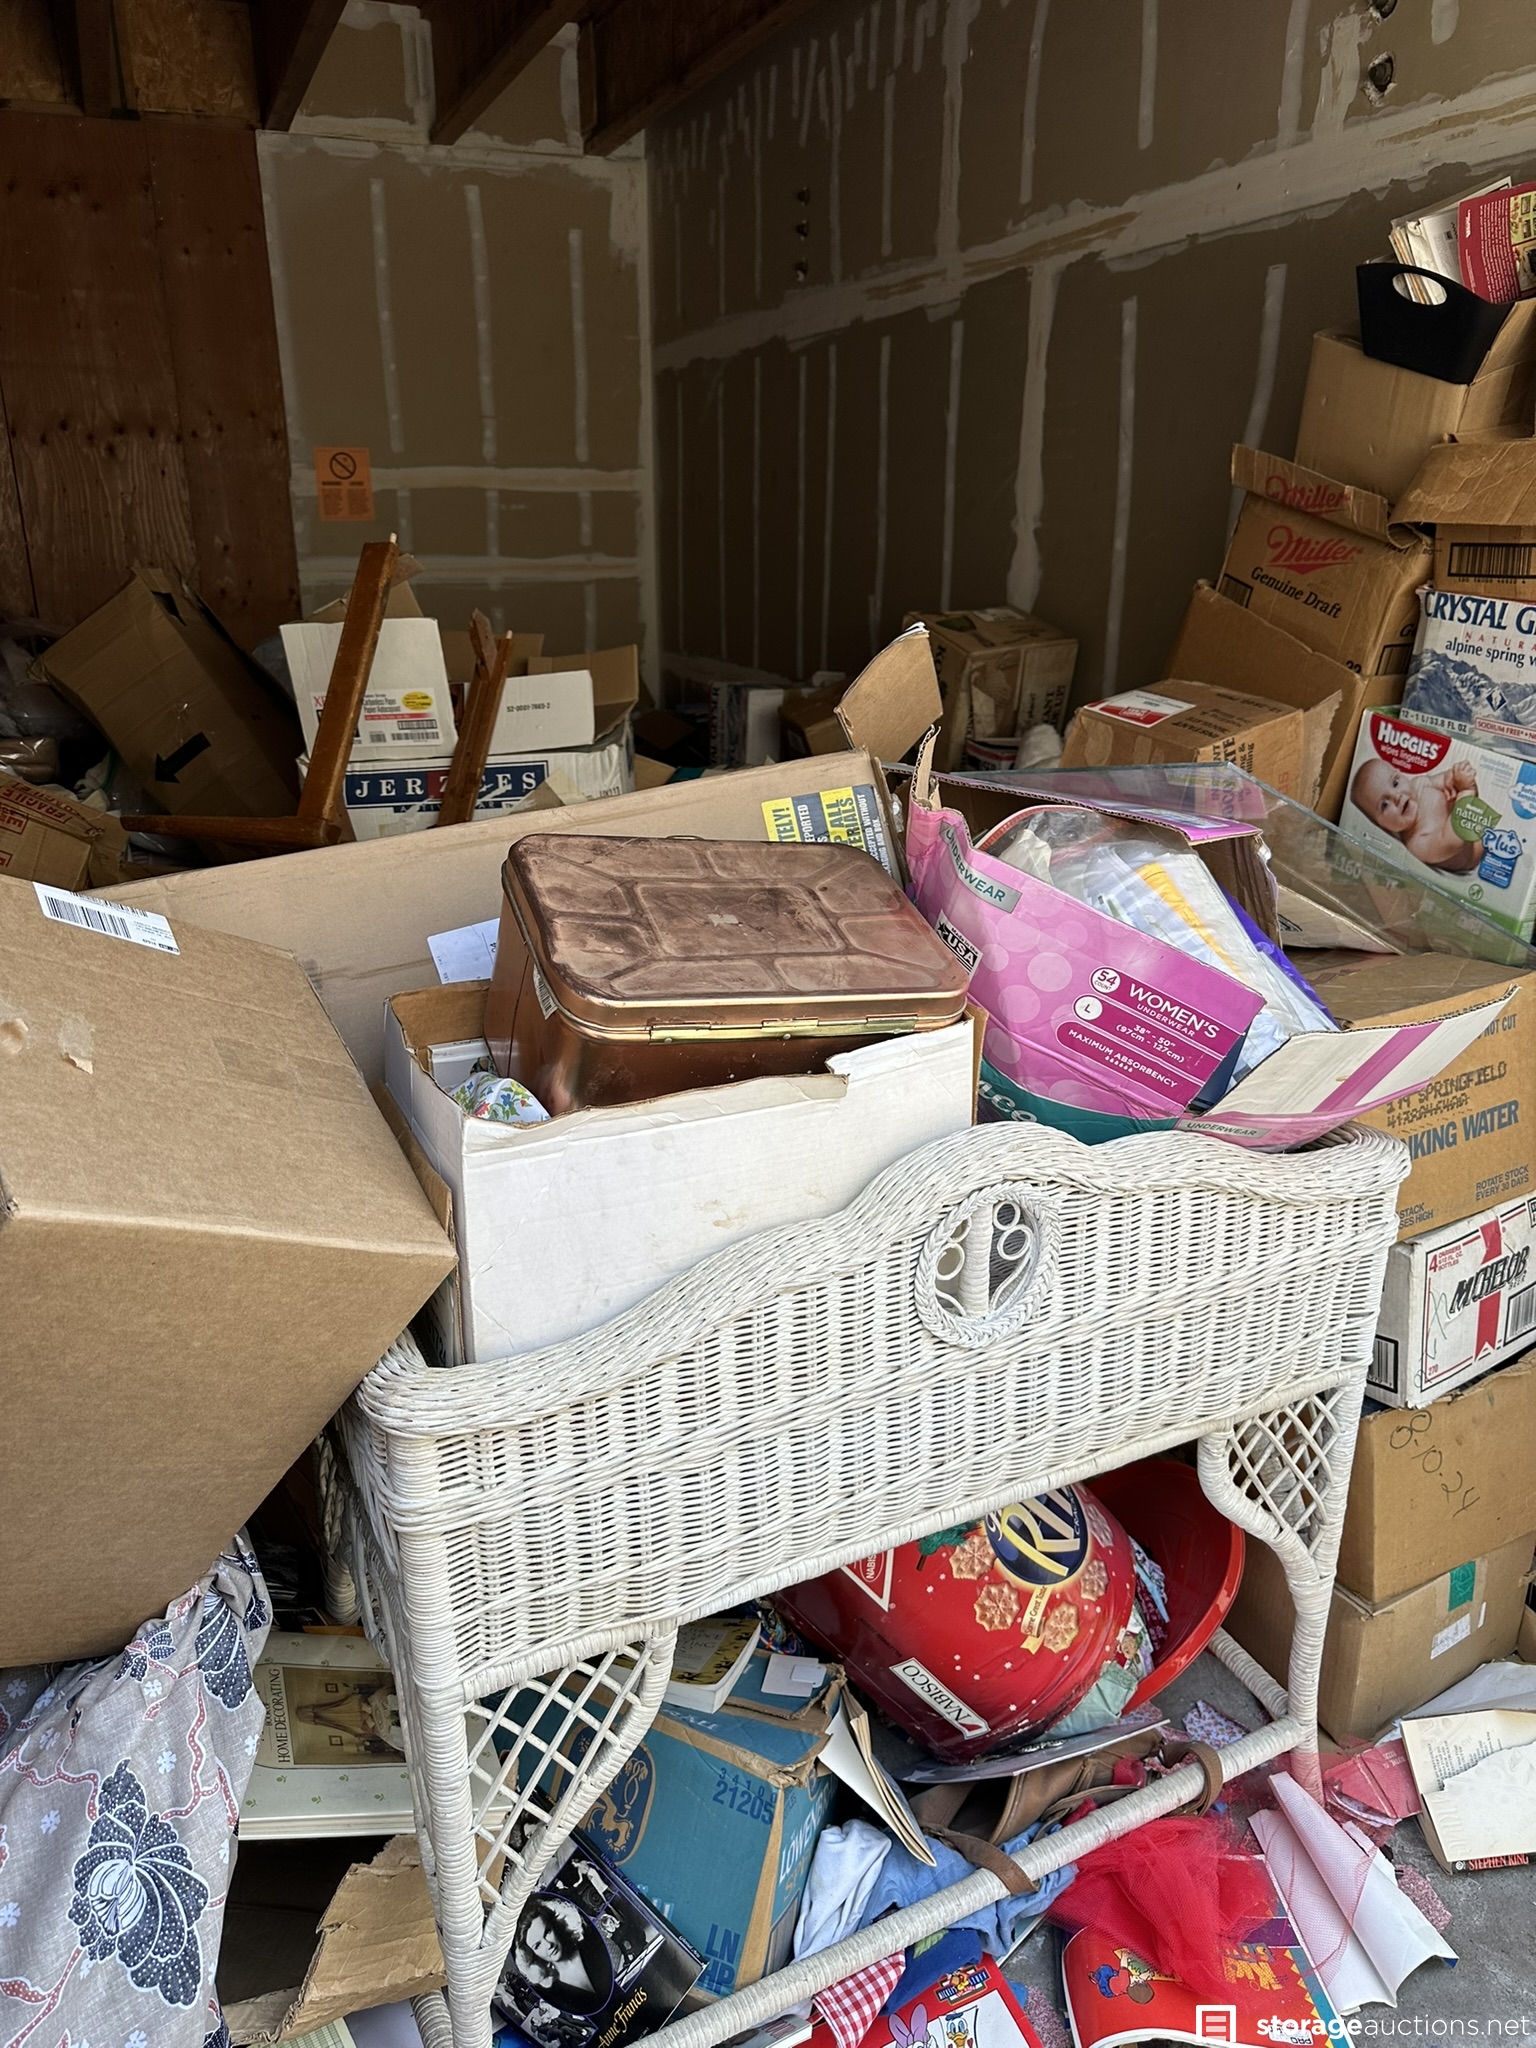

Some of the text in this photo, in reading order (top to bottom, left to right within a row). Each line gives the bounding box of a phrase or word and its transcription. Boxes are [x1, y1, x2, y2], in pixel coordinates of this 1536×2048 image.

[1265, 475, 1352, 510] Miller
[1267, 525, 1364, 565] Miller
[1251, 566, 1342, 619] Genuine Draft
[1425, 591, 1509, 630] CRYSTAL
[1445, 637, 1525, 669] alpine spring
[1401, 709, 1410, 718] 12
[1447, 720, 1456, 730] FL
[1457, 722, 1468, 733] OZ
[1476, 720, 1505, 733] SODIUM
[826, 799, 845, 828] ALL
[857, 794, 872, 826] WITHOUT
[1456, 806, 1493, 828] natural
[1460, 819, 1482, 834] care
[1484, 830, 1518, 856] Plus
[945, 828, 1007, 902] UNDERWEAR
[947, 932, 979, 966] USA
[951, 927, 963, 940] Made
[967, 941, 979, 955] the
[1094, 979, 1112, 992] COUNT
[1097, 970, 1116, 986] 54
[1084, 1003, 1091, 1013] L
[1129, 983, 1220, 1039] WOMEN'S
[1137, 1003, 1195, 1037] UNDERWEAR
[1502, 1014, 1518, 1031] CUT
[1116, 1024, 1145, 1042] (97cm
[1153, 1044, 1185, 1063] 127cm)
[1068, 1029, 1178, 1088] MAXIMUM ABSORBENCY
[1418, 1061, 1508, 1104] SPRINGFIELD
[1187, 1122, 1257, 1136] UNDERWEAR
[1462, 1100, 1520, 1141] WATER
[1476, 1165, 1529, 1191] ROTATE STOCK
[1476, 1174, 1529, 1201] EVERY 30 DAYS
[1400, 1203, 1426, 1219] STACK
[1415, 1209, 1434, 1225] HIGH
[1429, 1254, 1438, 1272] 4
[1428, 1364, 1439, 1376] 270
[1030, 1599, 1042, 1618] Great
[902, 1664, 972, 1722] NABISCO
[268, 1668, 291, 1763] HOME DECORATING
[712, 1780, 774, 1825] 21205
[1468, 1853, 1529, 1871] STEPHEN KING
[705, 1923, 741, 1965] LN
[598, 1987, 648, 2048] Anne Francis
